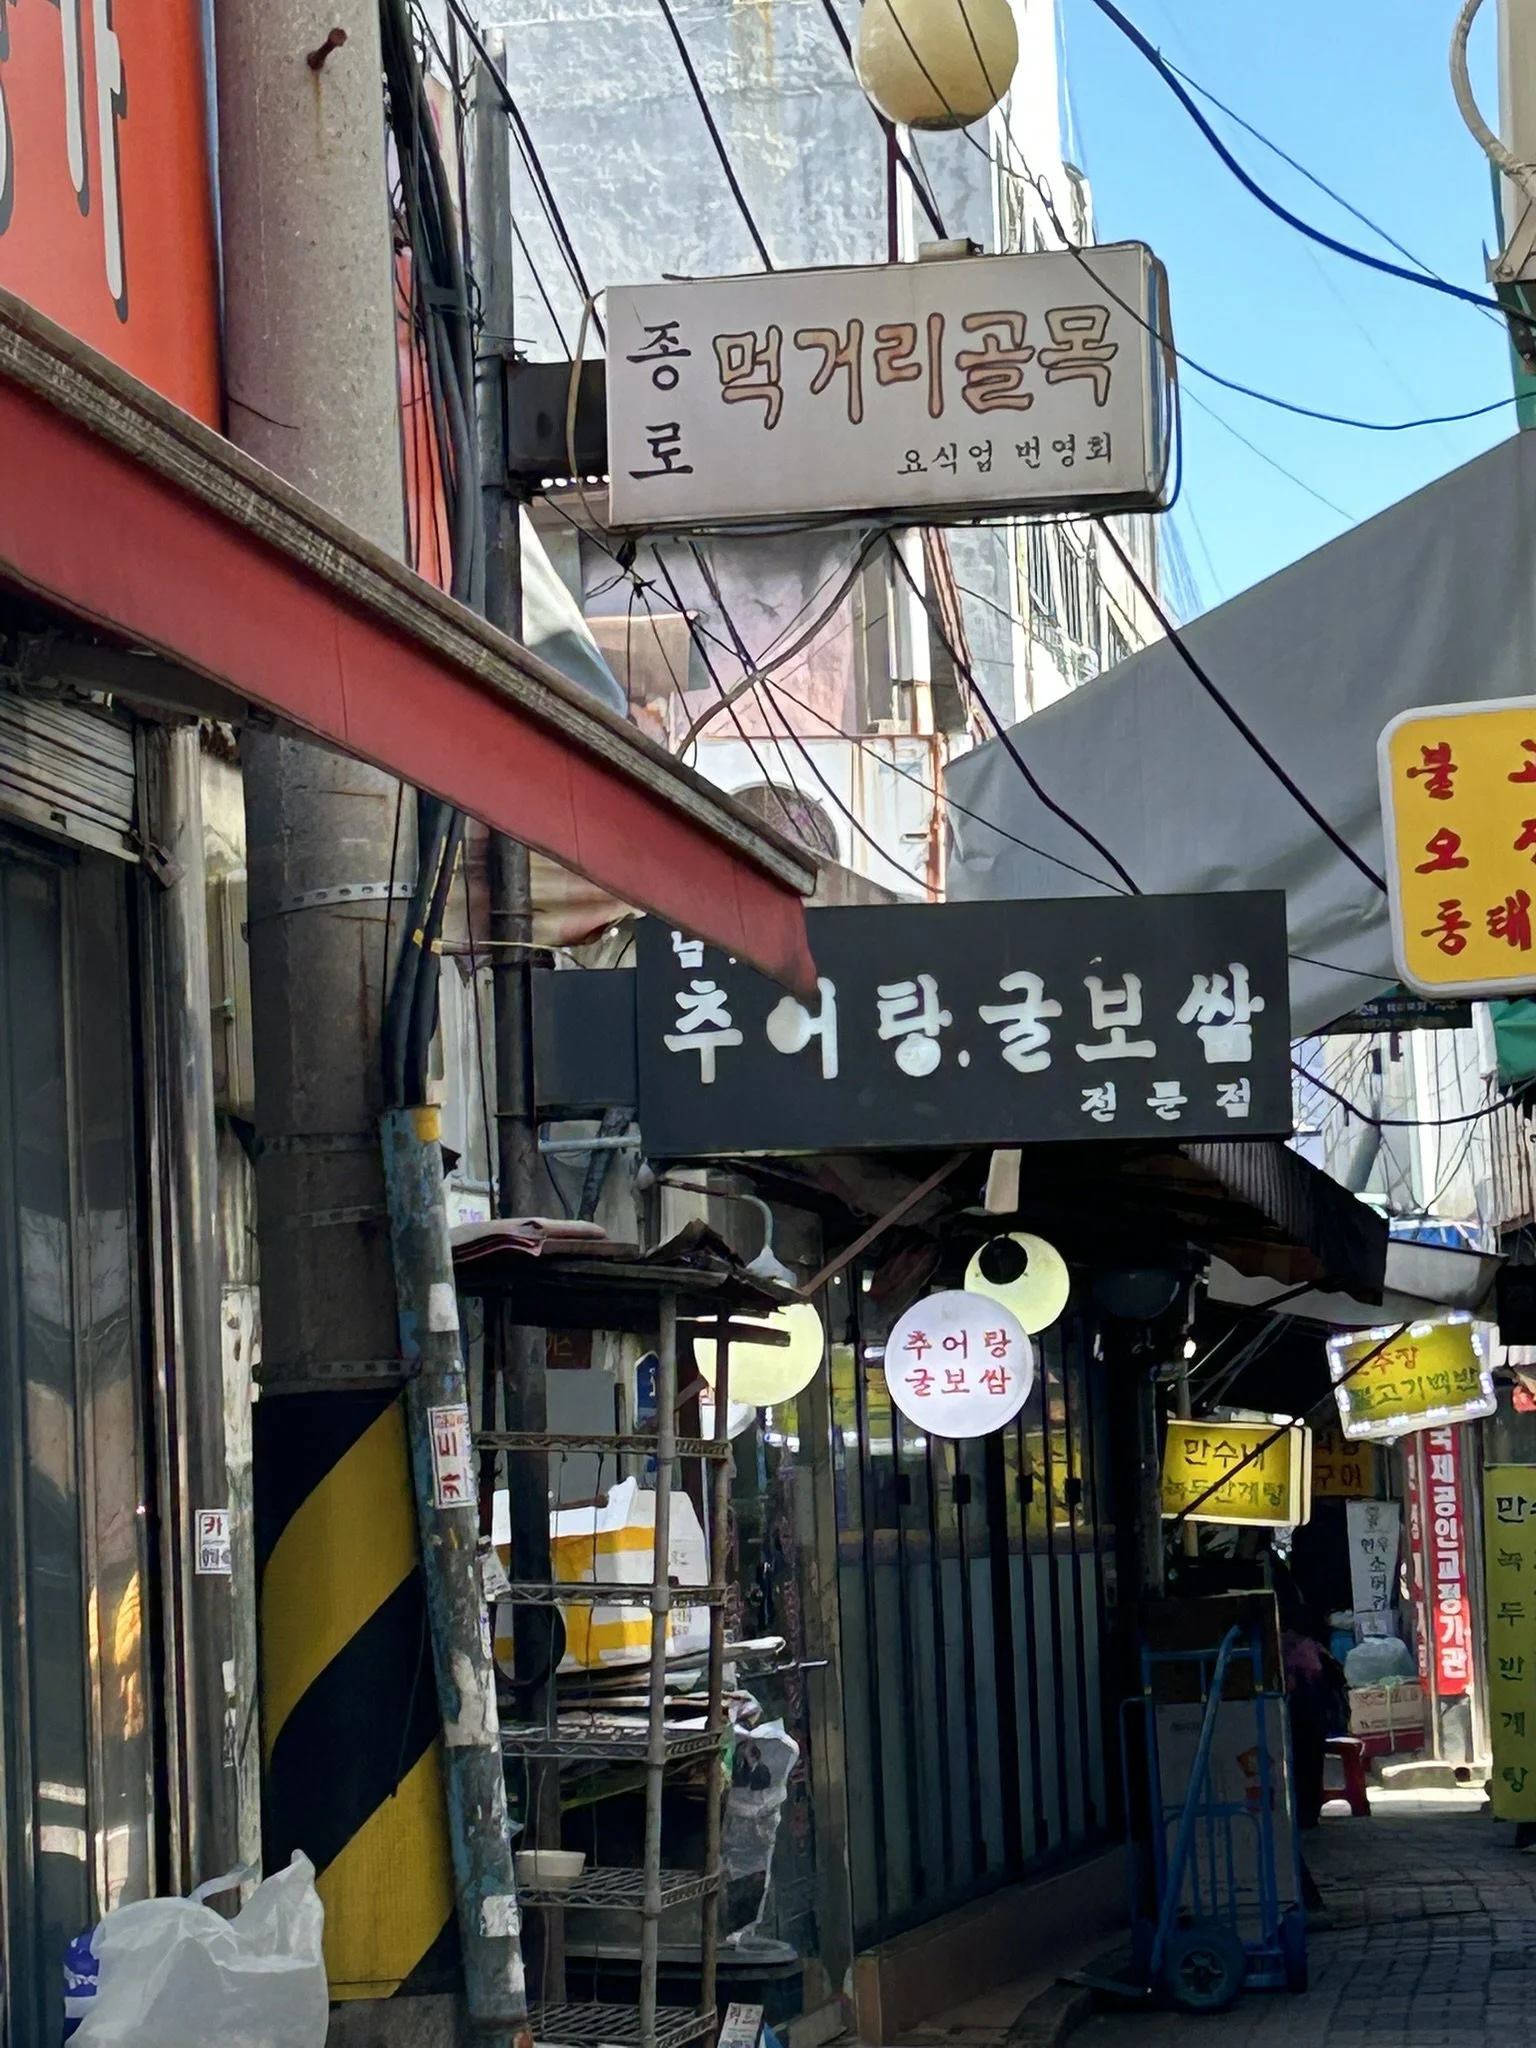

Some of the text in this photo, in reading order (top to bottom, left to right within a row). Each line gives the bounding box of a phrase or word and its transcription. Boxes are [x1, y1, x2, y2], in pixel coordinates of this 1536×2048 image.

[711, 304, 1119, 431] 먹거리골목
[626, 320, 694, 480] 종로
[896, 431, 1113, 476] 요식업 번영회
[1081, 1077, 1252, 1122] 전문점
[903, 1328, 1012, 1361] 추어탕
[904, 1364, 1012, 1397] 굴보쌈
